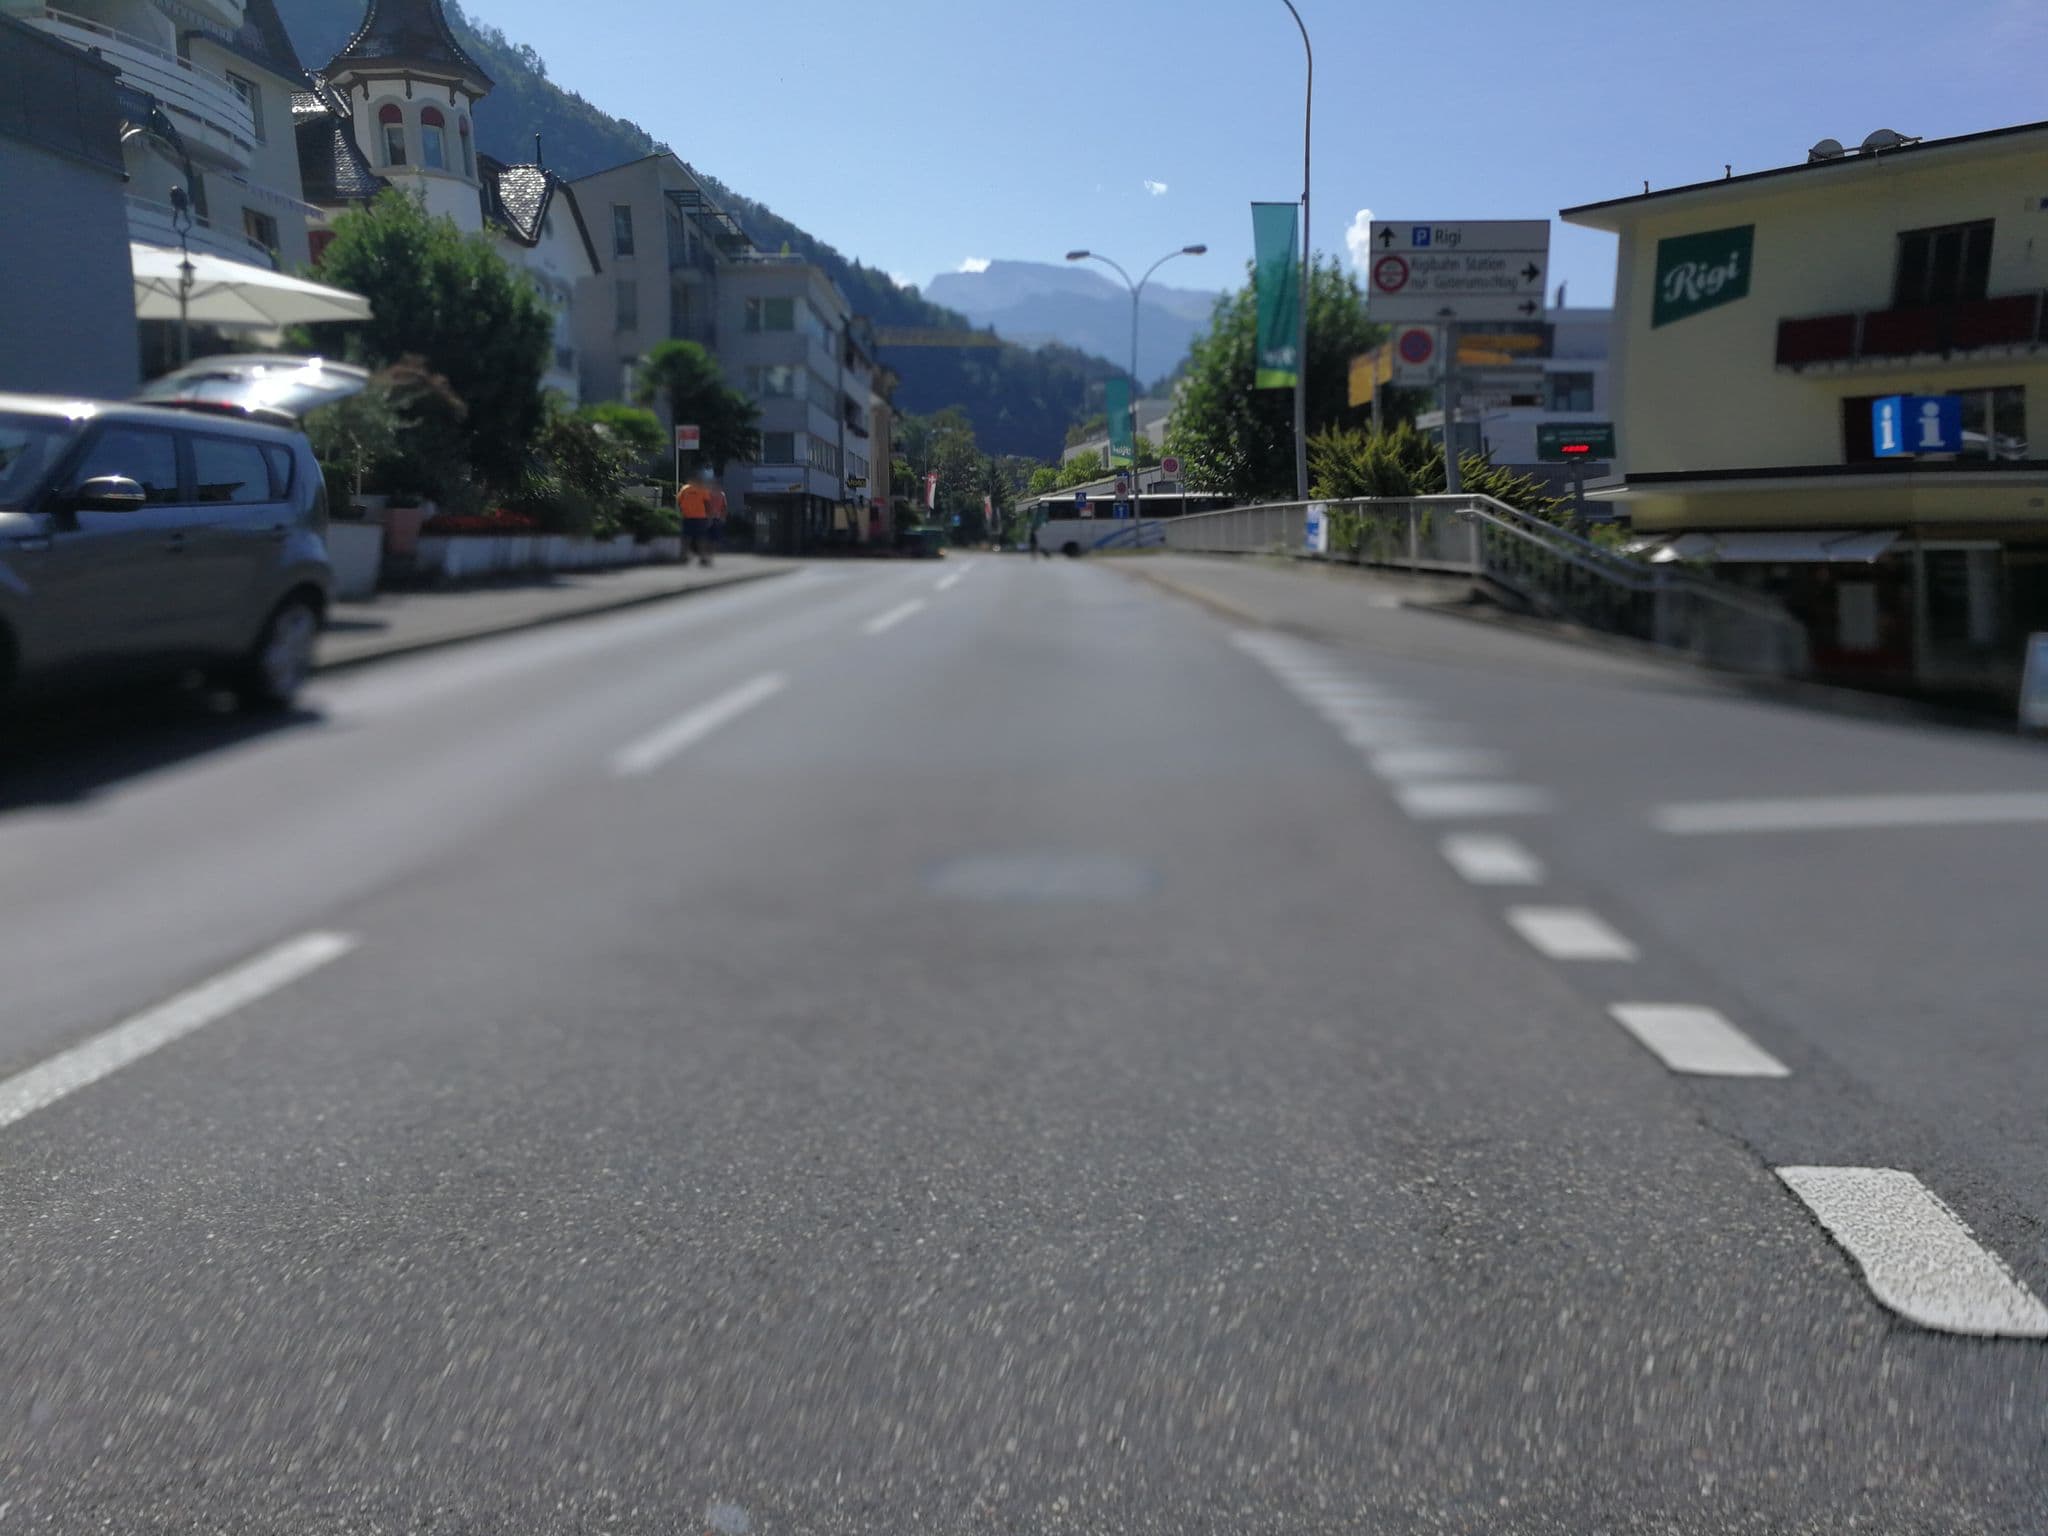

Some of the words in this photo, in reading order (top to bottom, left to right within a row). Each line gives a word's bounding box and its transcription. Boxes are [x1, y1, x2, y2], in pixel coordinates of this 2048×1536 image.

[1435, 228, 1462, 247] Rigi
[1465, 255, 1506, 271] Station
[1663, 251, 1739, 302] Rigi
